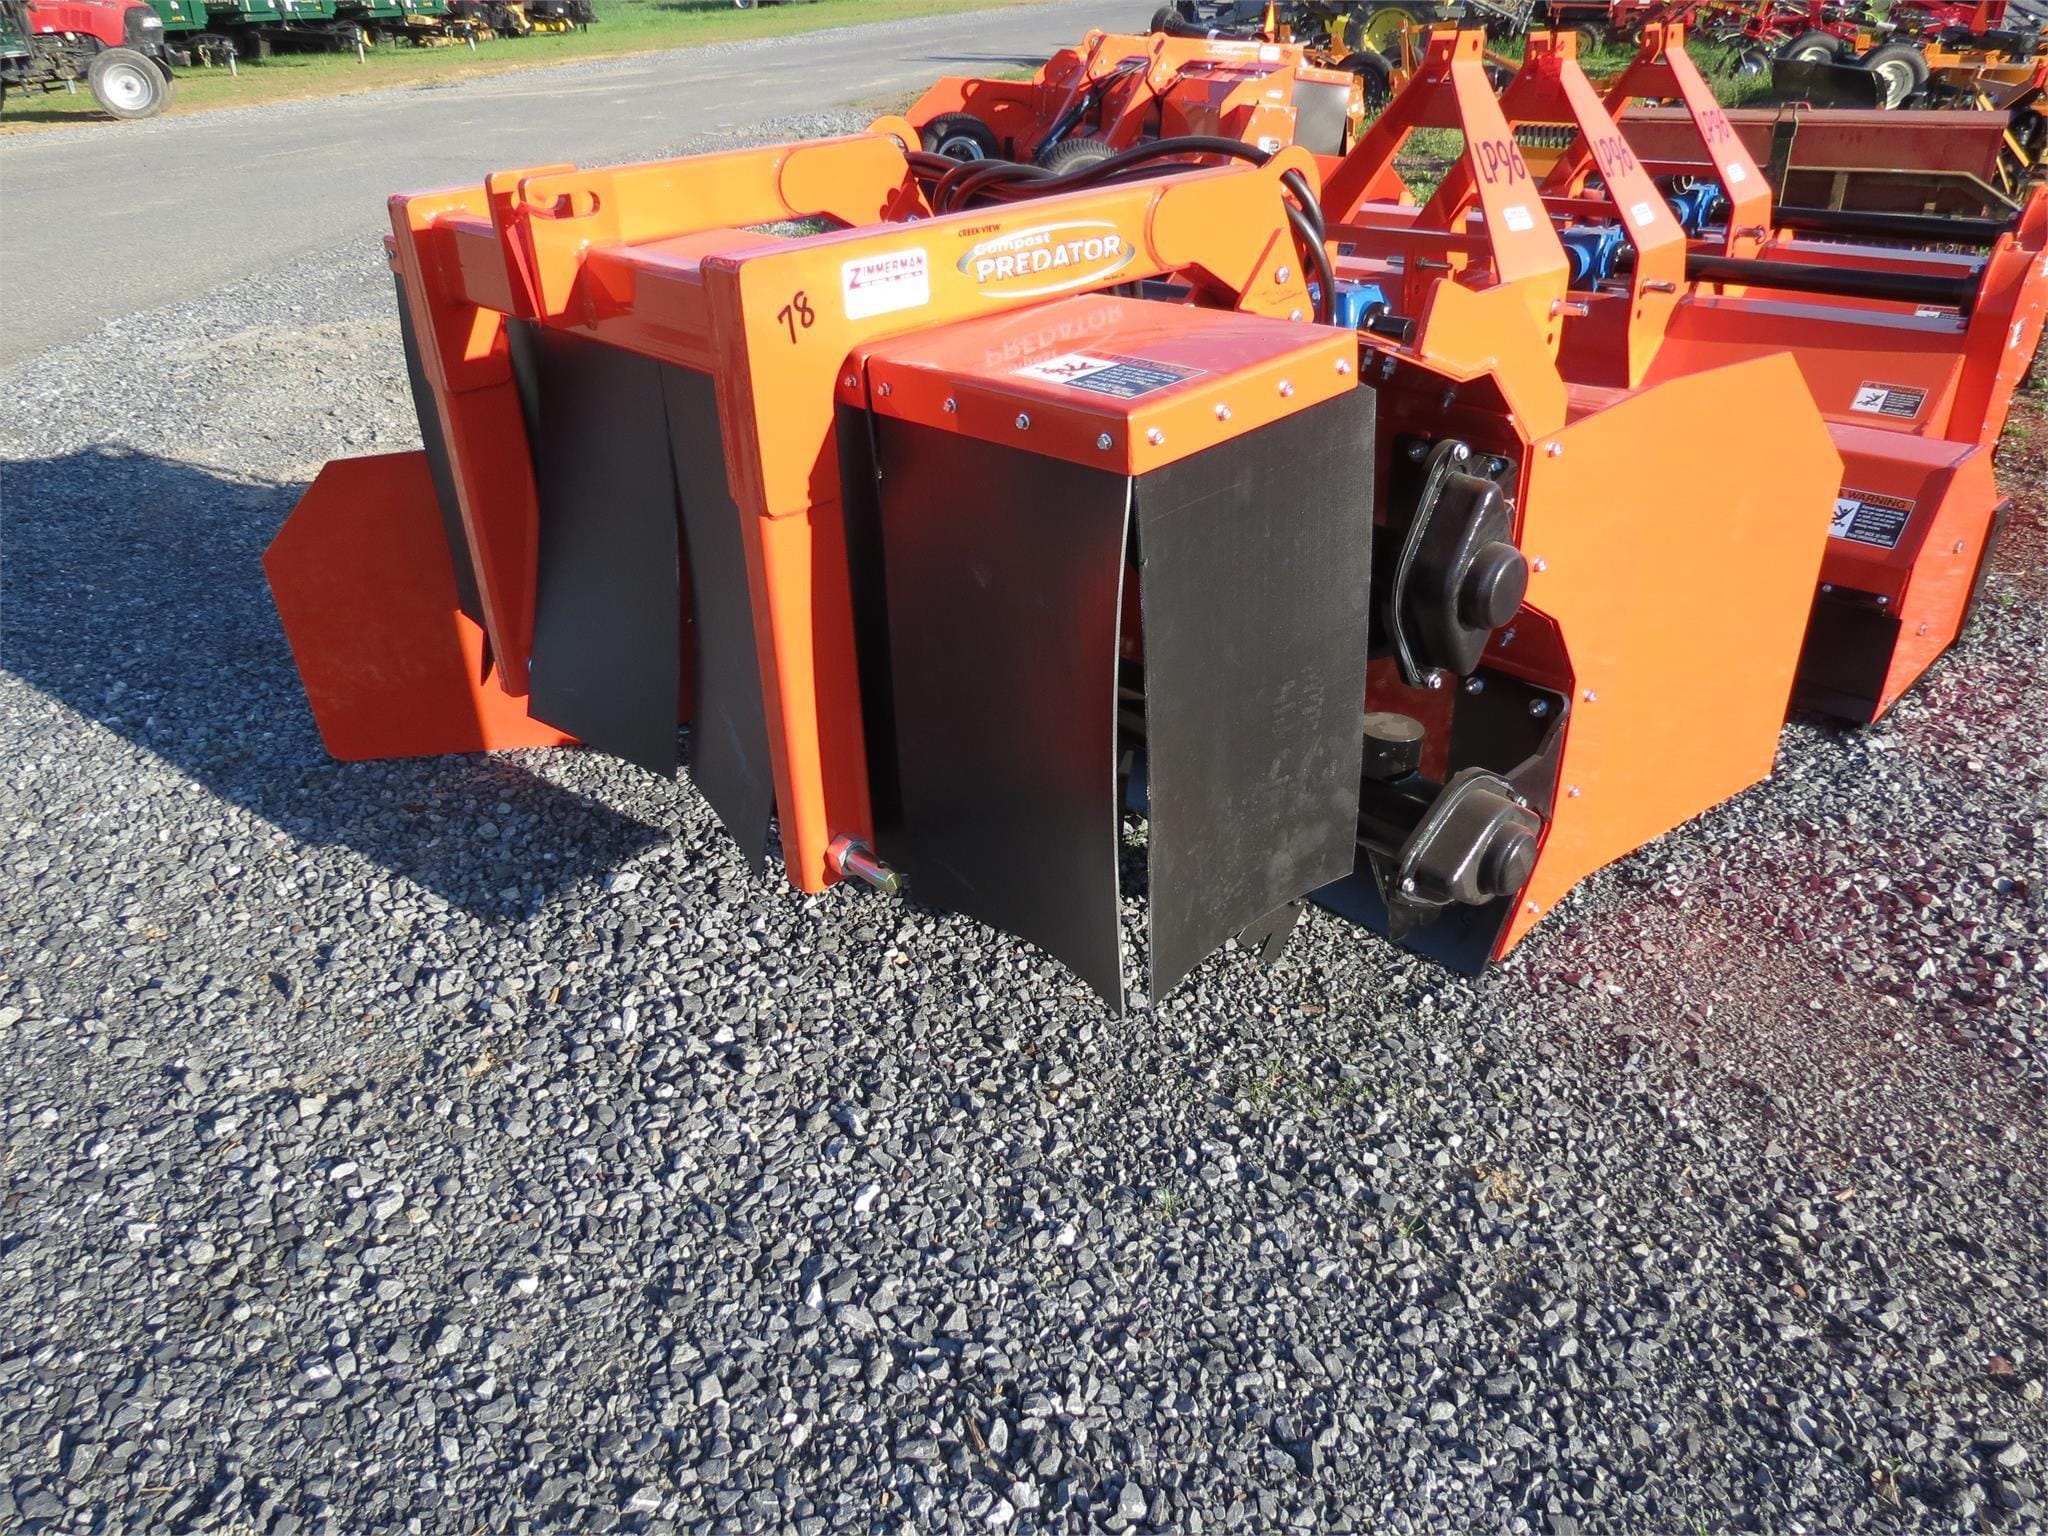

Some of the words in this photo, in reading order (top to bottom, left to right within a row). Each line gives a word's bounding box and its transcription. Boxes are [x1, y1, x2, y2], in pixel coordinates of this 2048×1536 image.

[1698, 109, 1730, 144] LP96
[1474, 140, 1526, 185] LP96
[1593, 135, 1633, 178] LP96
[958, 227, 981, 238] CREEK
[981, 223, 1001, 234] VIEW
[849, 255, 923, 290] ZIMMERMAN
[976, 234, 1122, 284] PREDATOR
[777, 290, 816, 345] 78
[1848, 490, 1907, 509] WARNING
